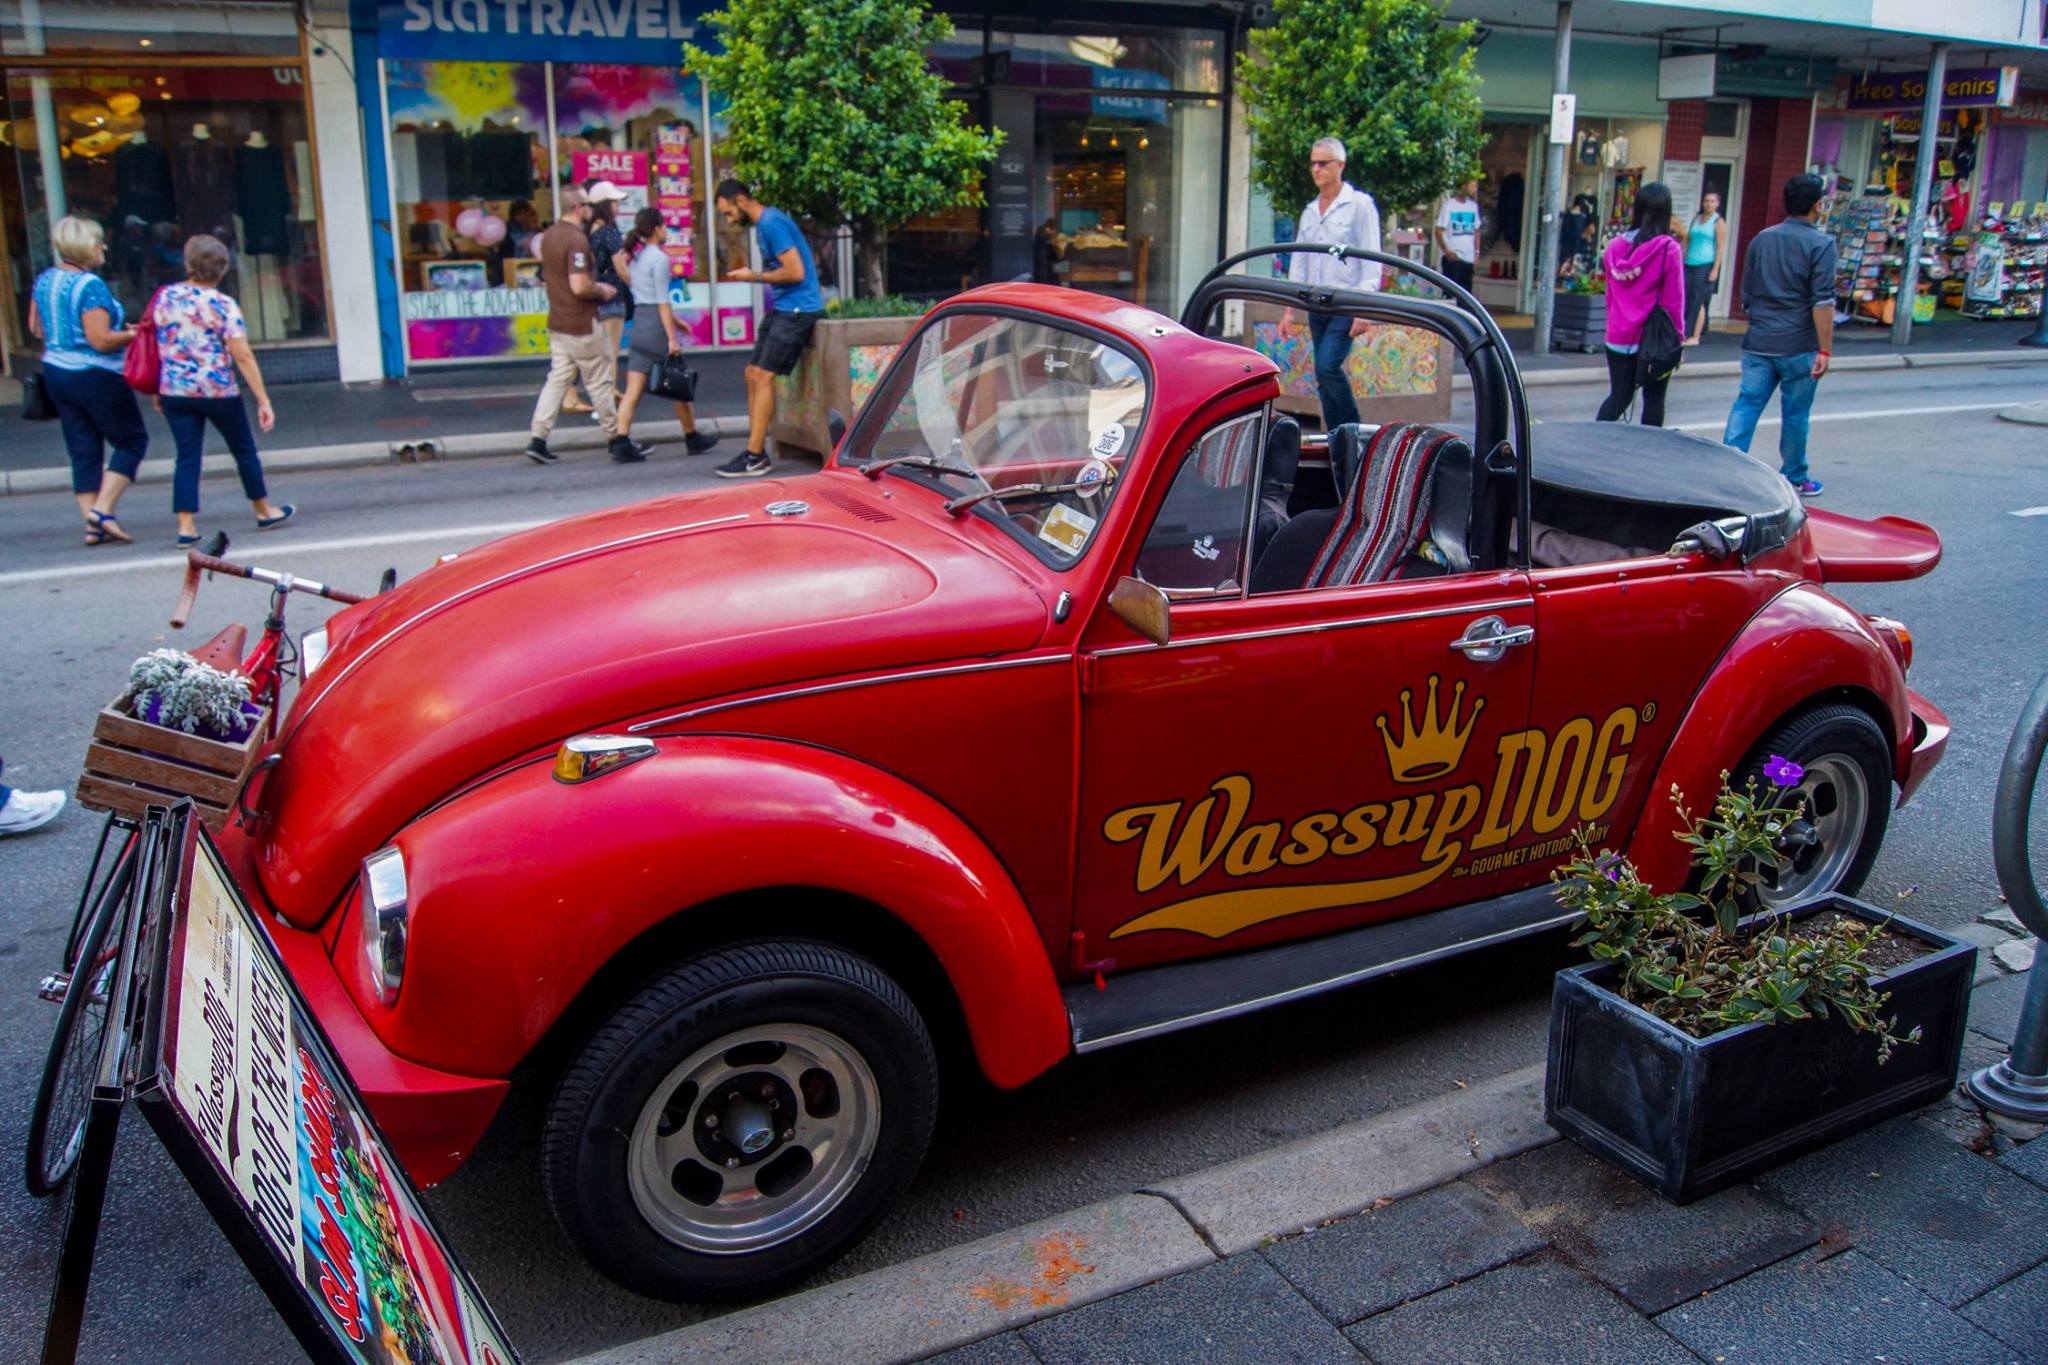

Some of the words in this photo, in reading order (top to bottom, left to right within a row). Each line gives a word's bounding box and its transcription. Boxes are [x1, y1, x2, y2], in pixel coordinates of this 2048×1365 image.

[496, 0, 696, 38] TRAVEL
[1902, 76, 1997, 99] Soenirs
[587, 155, 633, 171] SALE
[409, 291, 448, 317] START
[456, 289, 478, 316] THE
[484, 286, 549, 316] ADVENTUR
[1103, 773, 1482, 892] Wassup
[1470, 846, 1529, 876] GOURMET
[1529, 835, 1574, 861] HOTDOG
[251, 1026, 290, 1134] THE
[251, 1089, 292, 1188] OF
[251, 1147, 297, 1278] DOG
[314, 1194, 365, 1342] SLIM
